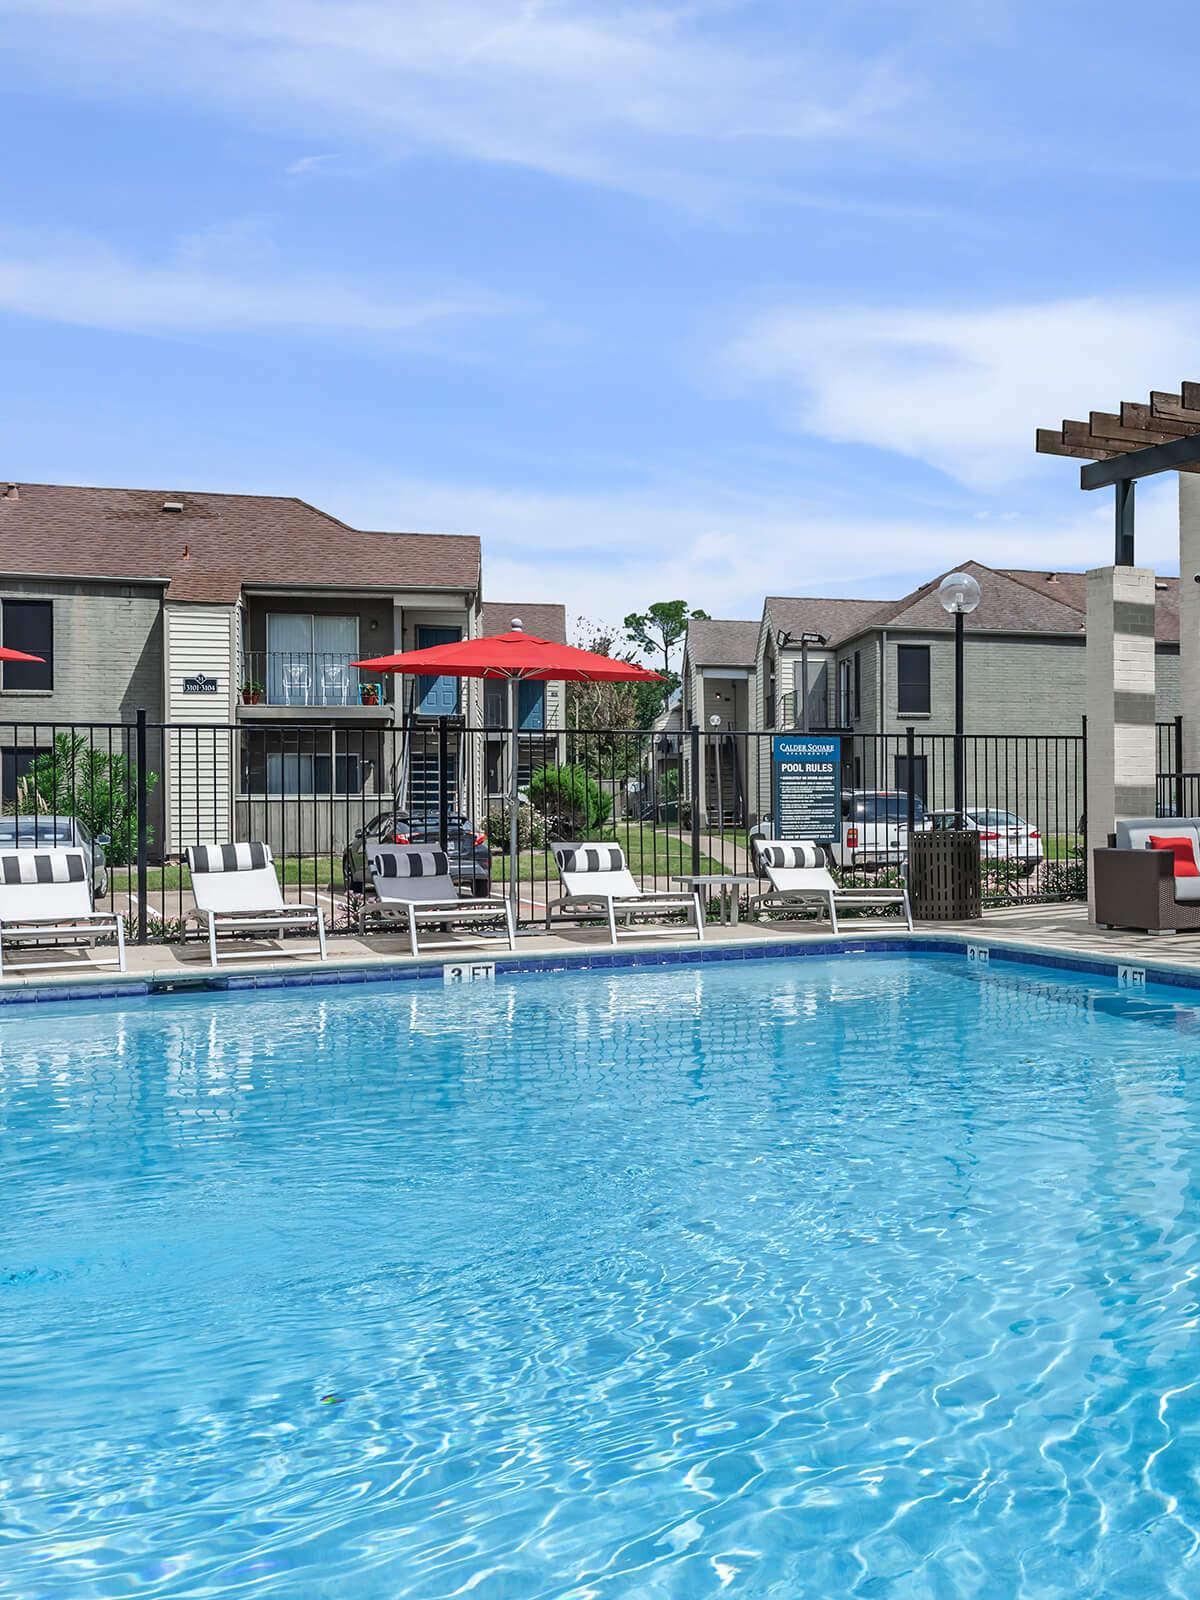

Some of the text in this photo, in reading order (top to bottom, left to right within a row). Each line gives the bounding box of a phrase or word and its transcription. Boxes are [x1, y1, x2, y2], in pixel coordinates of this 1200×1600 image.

[779, 743, 835, 752] CALDER SQUARE
[781, 763, 833, 773] POOL RULES
[472, 965, 492, 979] FT
[1132, 970, 1144, 983] FT
